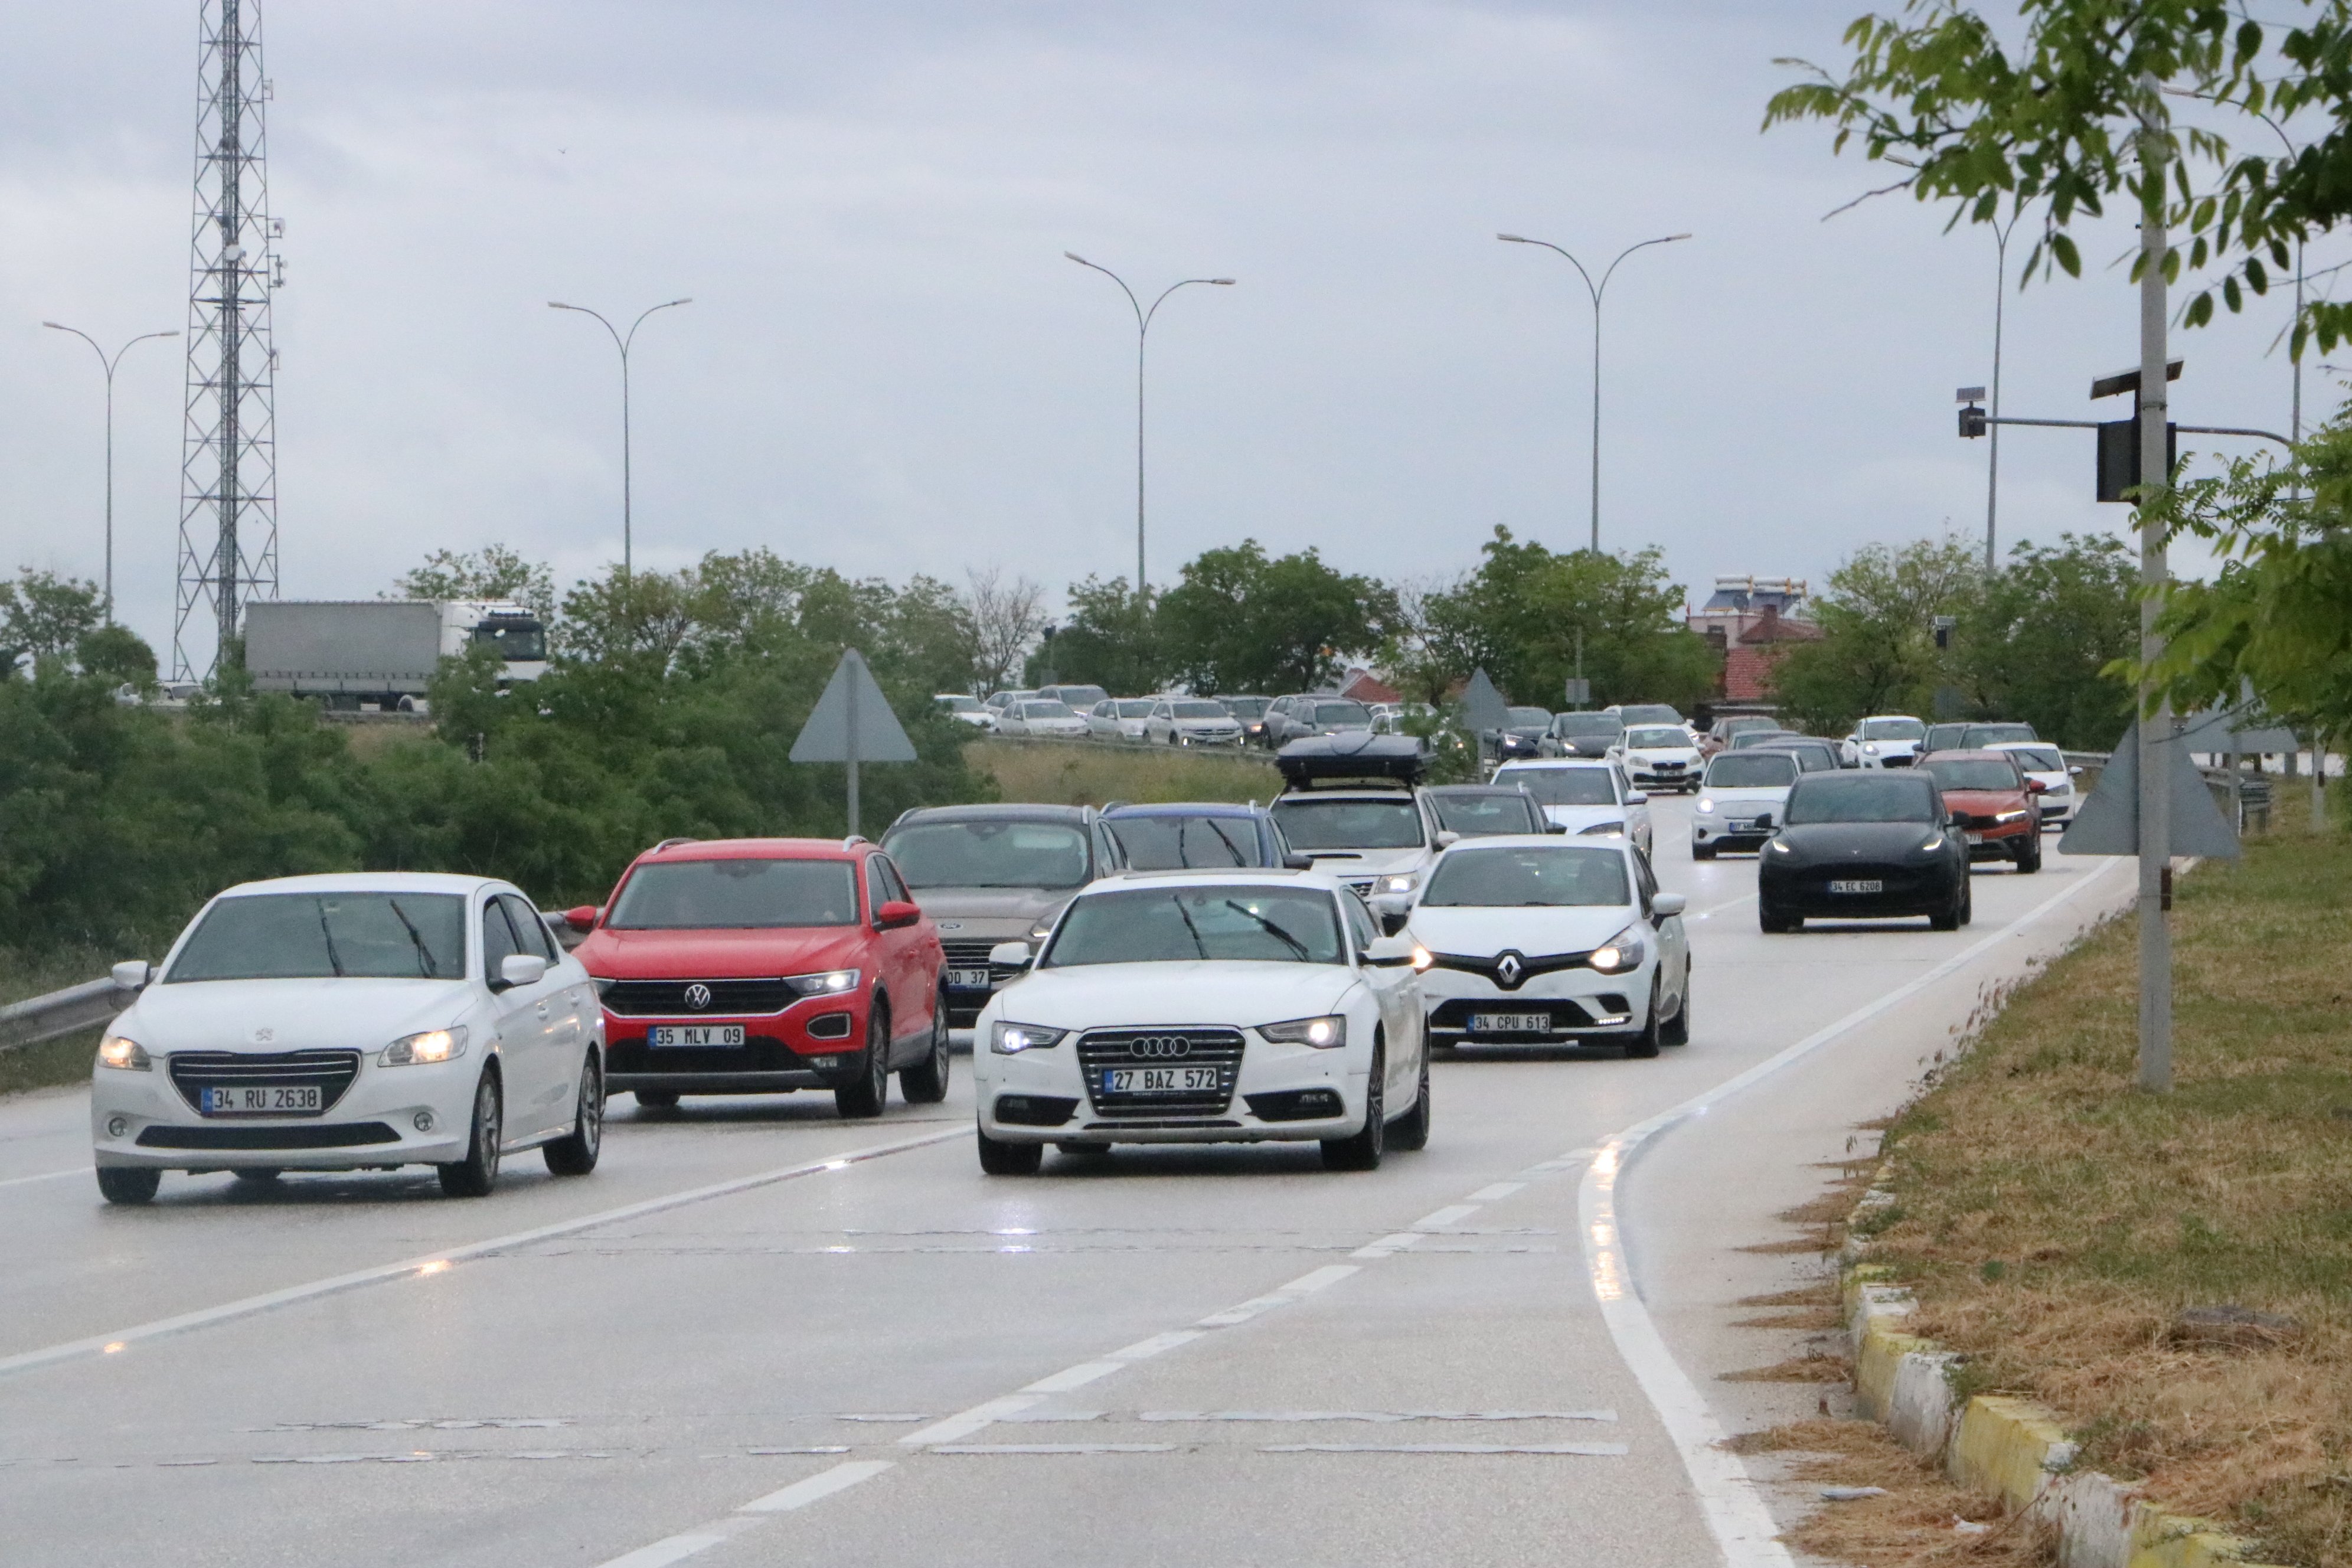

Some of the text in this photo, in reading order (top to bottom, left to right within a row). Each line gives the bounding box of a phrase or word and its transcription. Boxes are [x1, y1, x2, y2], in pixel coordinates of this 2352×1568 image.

[1833, 883, 1843, 891] 34
[971, 971, 985, 984] 37
[1476, 1015, 1549, 1029] 34 CPU 613
[657, 1028, 741, 1044] 35 MLV 09
[1114, 1072, 1133, 1090] 27
[1144, 1070, 1174, 1089] BAZ
[1185, 1069, 1216, 1088] 572
[214, 1089, 317, 1109] 34 RU 2638
